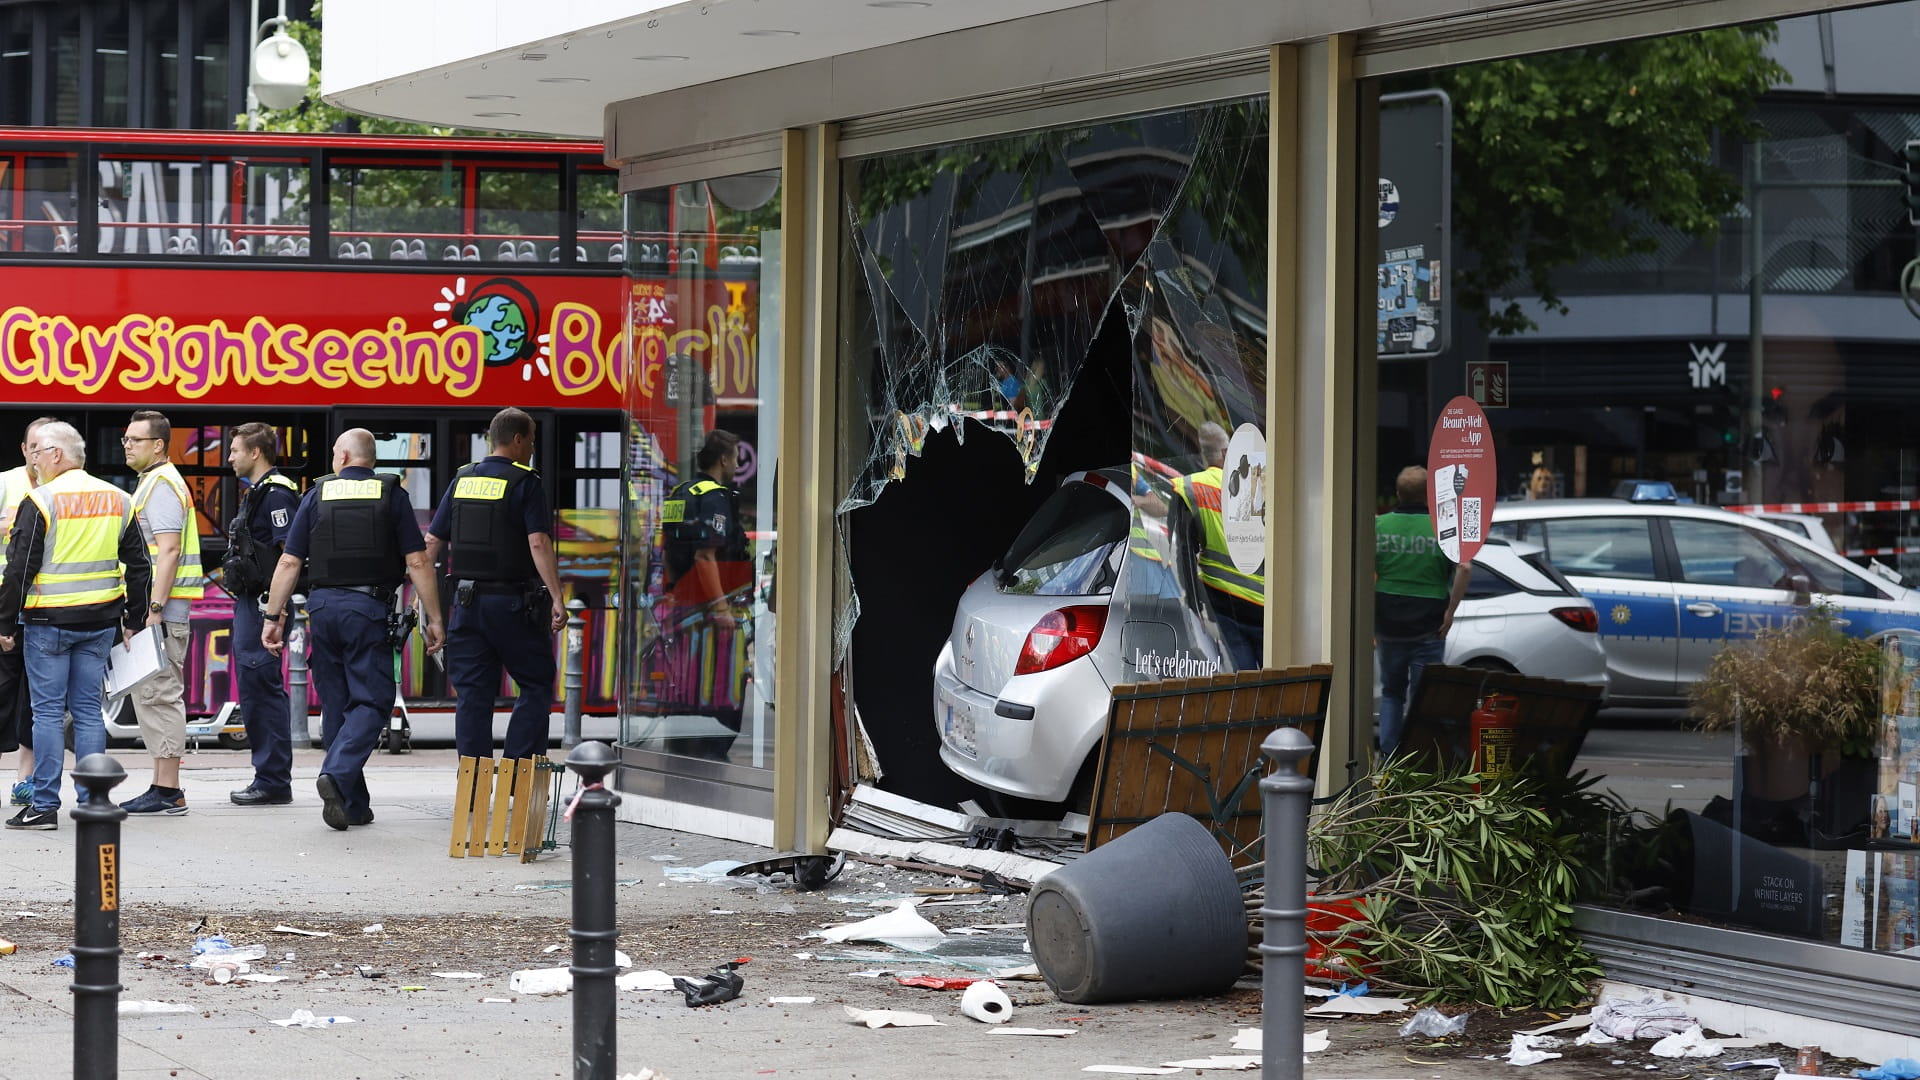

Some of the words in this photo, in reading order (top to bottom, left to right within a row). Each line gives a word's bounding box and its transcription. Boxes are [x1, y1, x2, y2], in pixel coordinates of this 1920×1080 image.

[0, 306, 484, 398] CitySightseeing
[1442, 414, 1482, 432] Beauty-Welt
[1469, 430, 1482, 446] App
[326, 481, 378, 497] POLIZEI
[458, 480, 503, 497] POLIZEI
[1135, 647, 1161, 676] Let's
[1163, 649, 1221, 678] celebrate!
[102, 847, 114, 898] ULTRAS
[1763, 876, 1783, 888] STACK
[1784, 878, 1794, 889] ON
[1754, 887, 1779, 901] INFINITE
[1780, 890, 1803, 904] LAYERS
